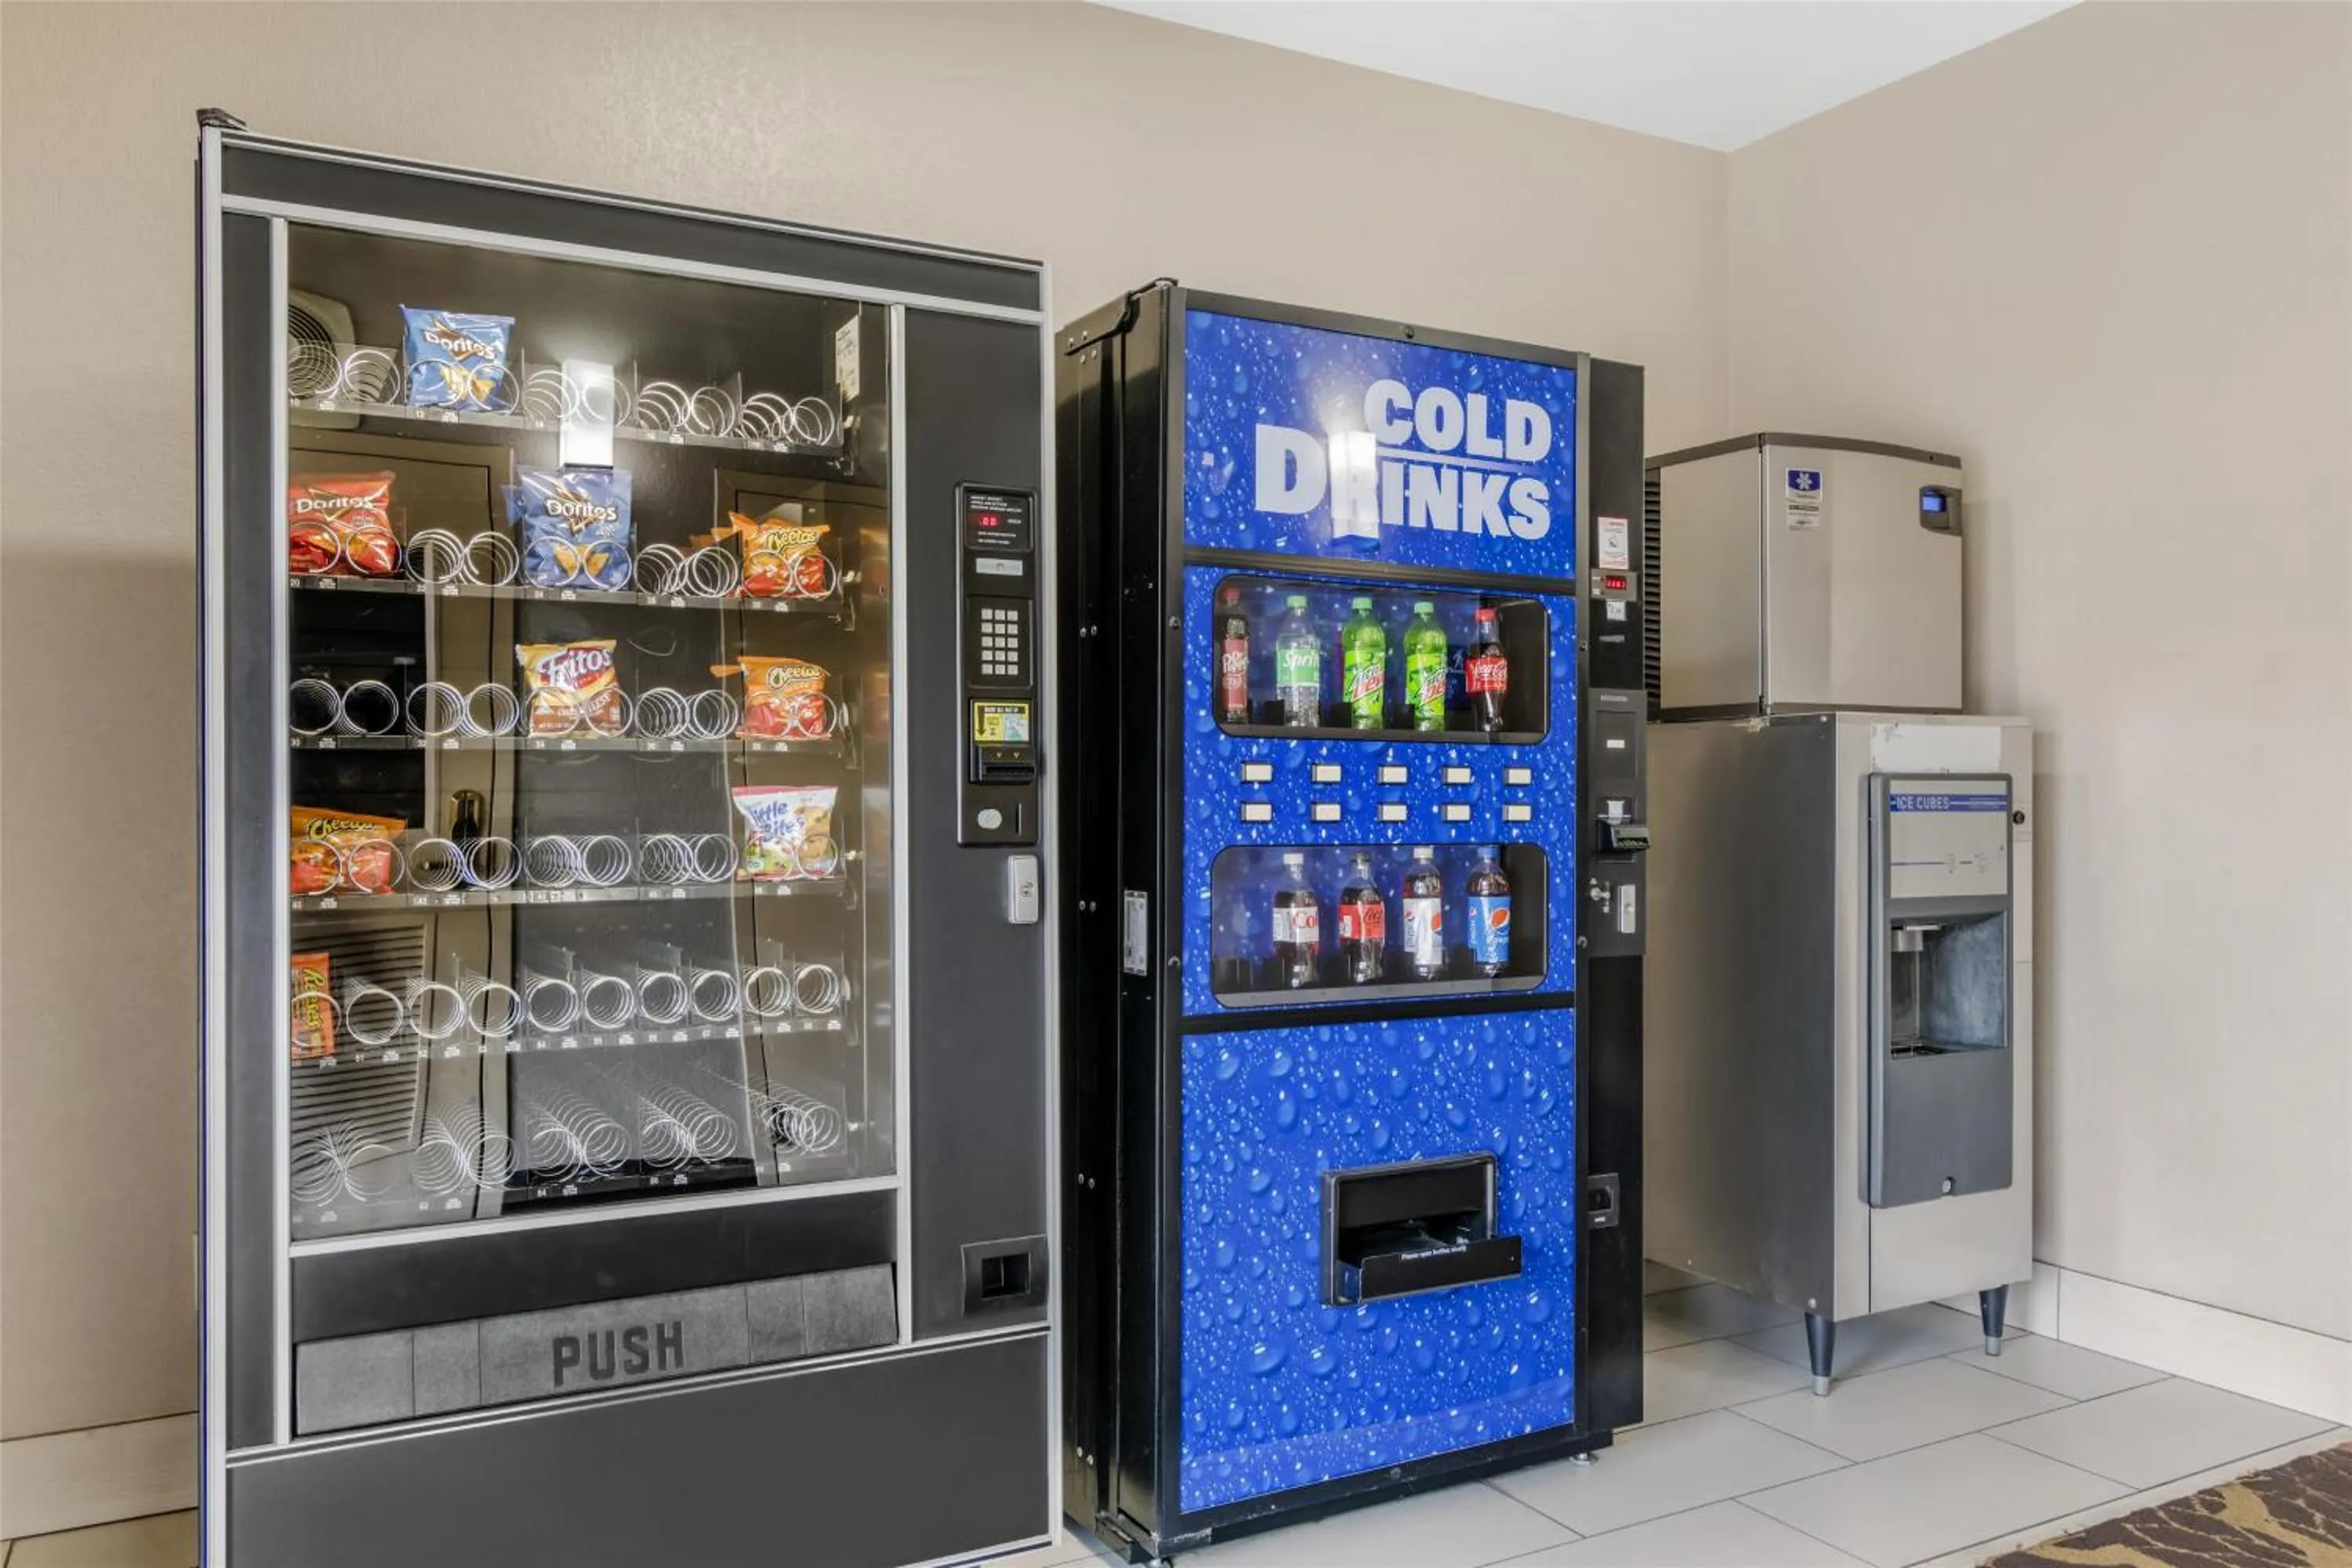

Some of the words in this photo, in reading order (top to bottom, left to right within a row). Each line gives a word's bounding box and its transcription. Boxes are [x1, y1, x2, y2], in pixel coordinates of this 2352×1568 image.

[424, 330, 497, 360] Doritos
[1363, 379, 1552, 462] COLD
[1254, 424, 1551, 539] DRINKS
[545, 499, 618, 521] Doritos
[536, 648, 614, 692] Fritos
[1896, 796, 1913, 810] ICE
[1916, 796, 1950, 810] CUBES
[552, 1321, 684, 1387] PUSH
